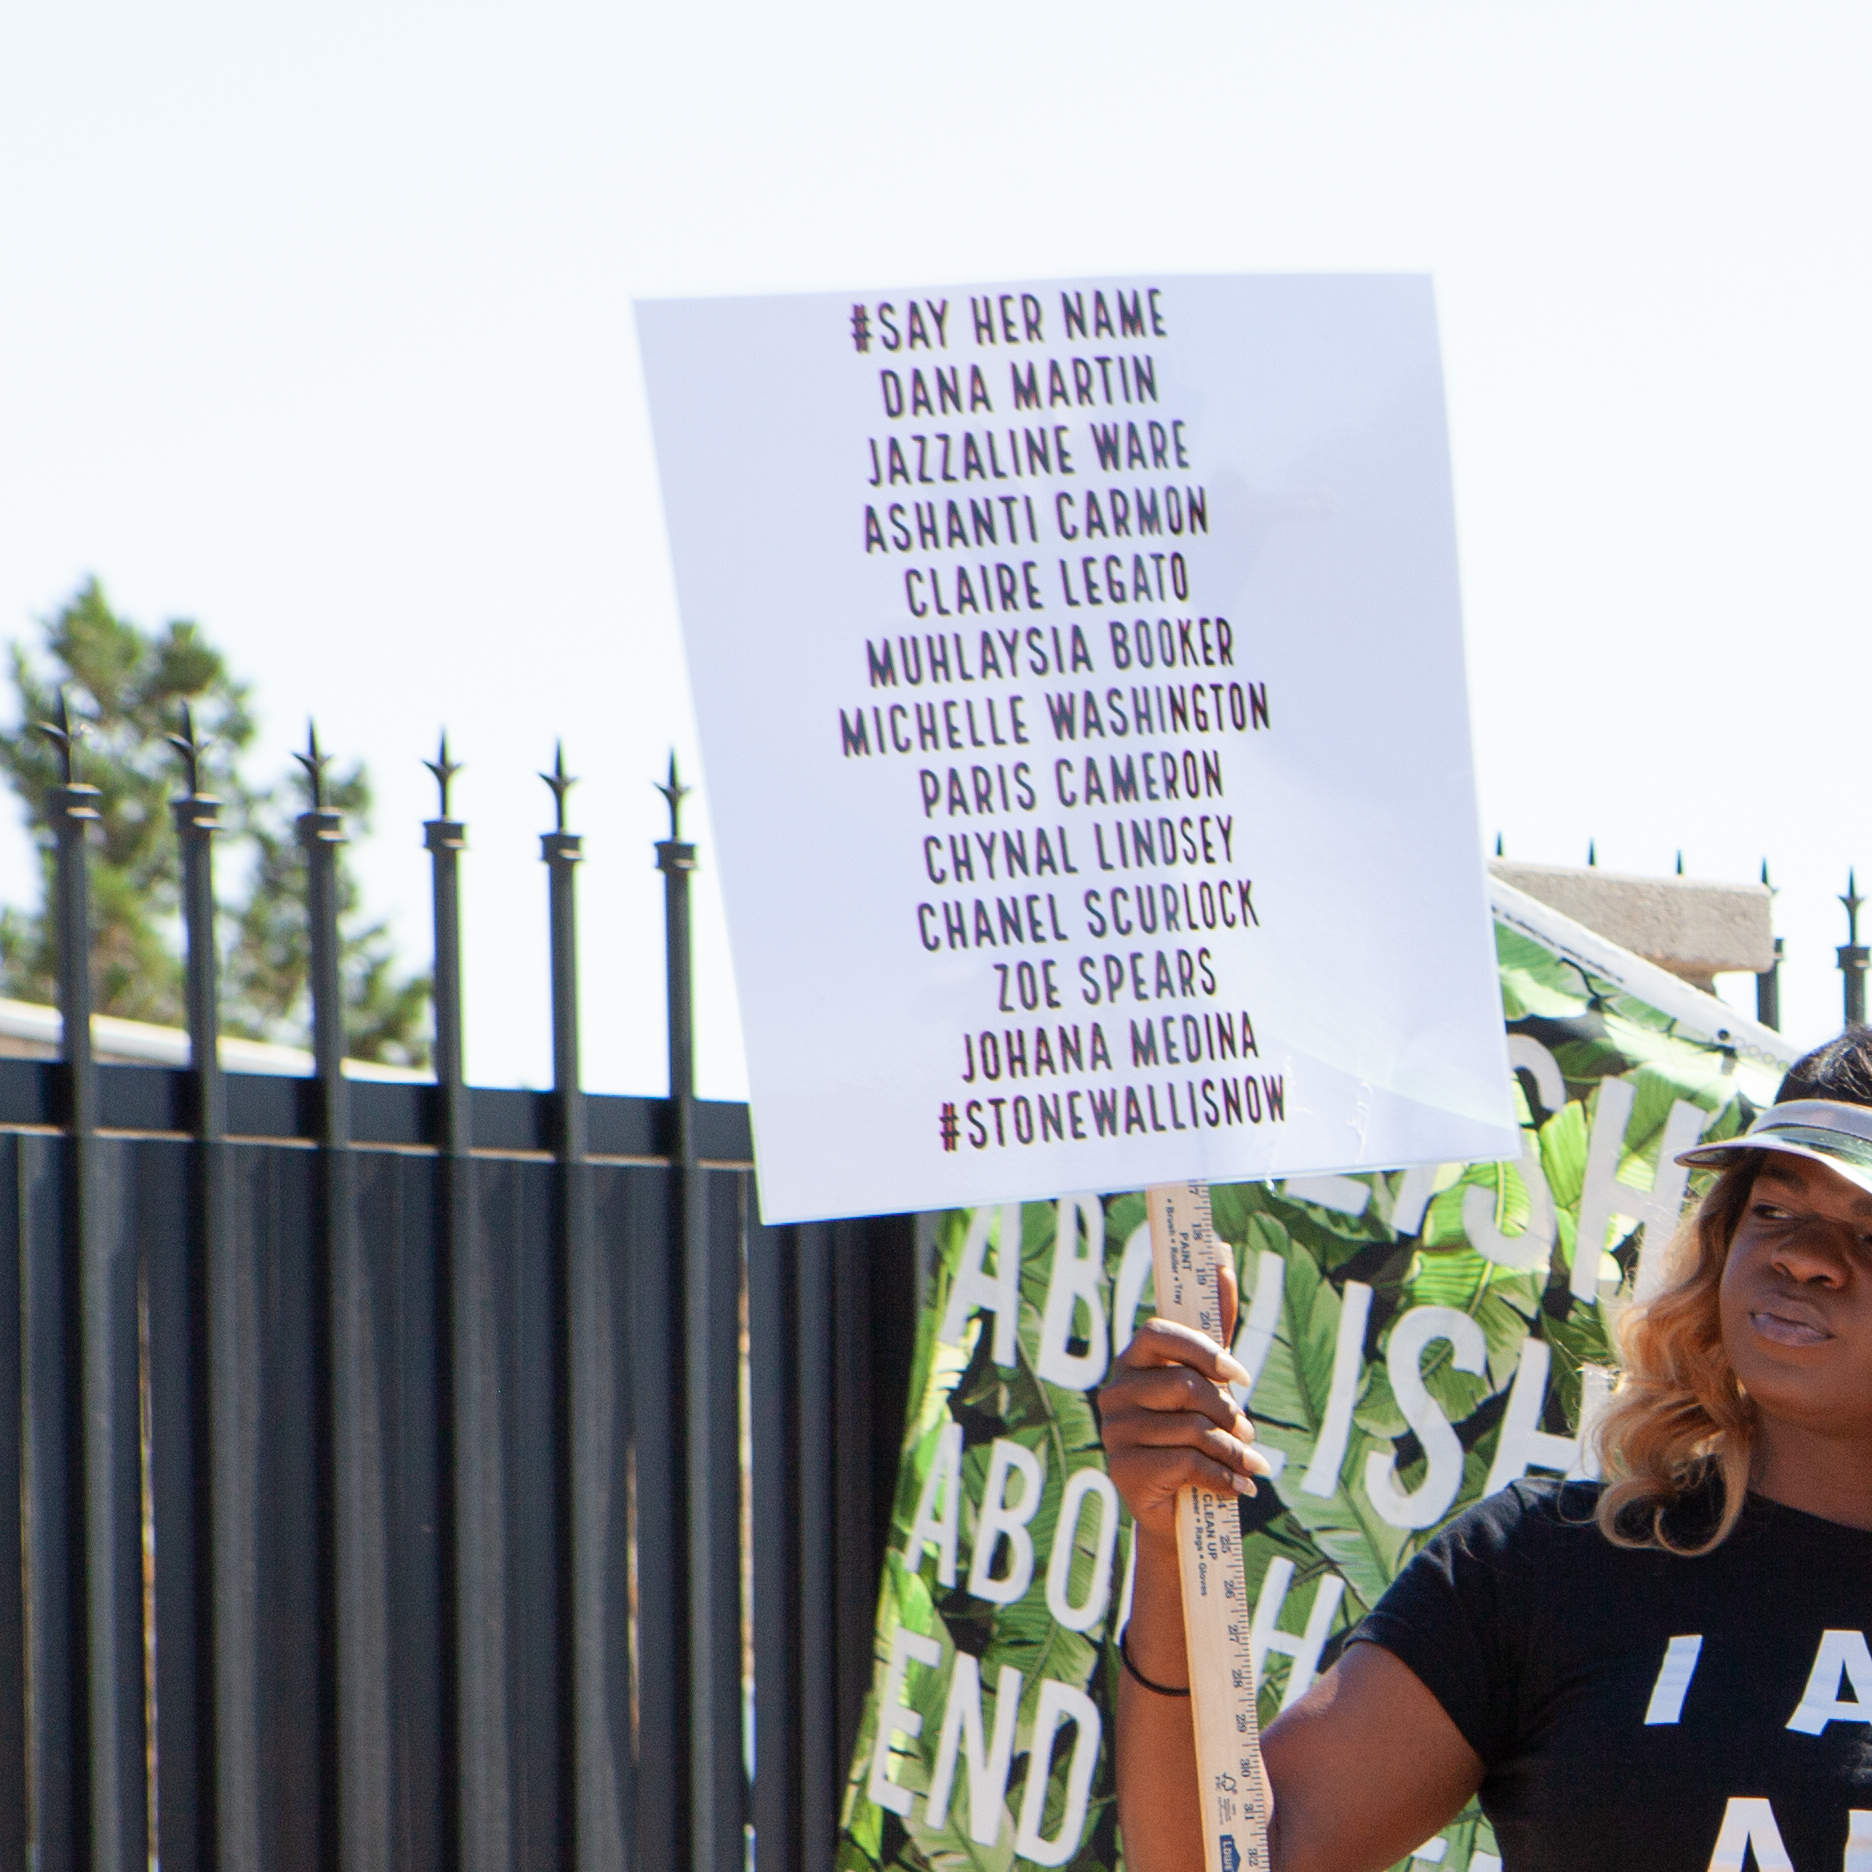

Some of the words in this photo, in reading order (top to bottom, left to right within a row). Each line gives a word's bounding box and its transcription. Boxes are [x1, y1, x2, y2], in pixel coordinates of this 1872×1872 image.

[848, 297, 950, 355] #SAY
[969, 291, 1045, 348] HER
[1059, 286, 1168, 342] NAME
[878, 362, 994, 421] DANA
[1009, 353, 1160, 412] MARTIN
[867, 423, 1077, 489] JAZZALINE
[1088, 418, 1191, 473] WARE
[863, 493, 1040, 555] ASHANTI
[1053, 484, 1210, 543] CARMON
[903, 559, 1046, 620] CLAIRE
[1057, 549, 1191, 609] LEGATO
[864, 622, 1096, 690] MUHLAYSIA
[1107, 615, 1236, 672] BOOKER
[837, 693, 1031, 759] MICHELLE
[1043, 680, 1272, 743] WASHINGTON
[917, 760, 1038, 820] PARIS
[1053, 748, 1225, 810] CAMERON
[921, 824, 1080, 887] CHYNAL
[1092, 813, 1234, 873] LINDSEY
[915, 891, 1070, 954] CHANEL
[1082, 878, 1261, 940] SCURLOCK
[991, 957, 1064, 1015] ZOE
[1077, 945, 1218, 1007] SPEARS
[960, 1020, 1114, 1085] JOHANA
[1128, 1009, 1261, 1070] MEDINA
[937, 1073, 1286, 1154] #STONEWALLISNOW
[1179, 1231, 1192, 1271] PAINT
[1192, 1223, 1202, 1241] 18
[1196, 1268, 1207, 1286] 19
[1200, 1310, 1210, 1330] 20
[1194, 1526, 1203, 1551] Rags
[1203, 1493, 1215, 1539] CLEAN
[1220, 1535, 1231, 1554] 25
[1207, 1542, 1218, 1561] UP
[1223, 1580, 1235, 1599] 26
[1228, 1624, 1240, 1643] 27
[1231, 1668, 1244, 1689] 28
[1644, 1633, 1703, 1725] I
[867, 1624, 1101, 1868] END
[1235, 1713, 1247, 1733] 29
[1240, 1758, 1252, 1778] 30
[1244, 1802, 1255, 1820] 31
[1247, 1847, 1259, 1867] 32
